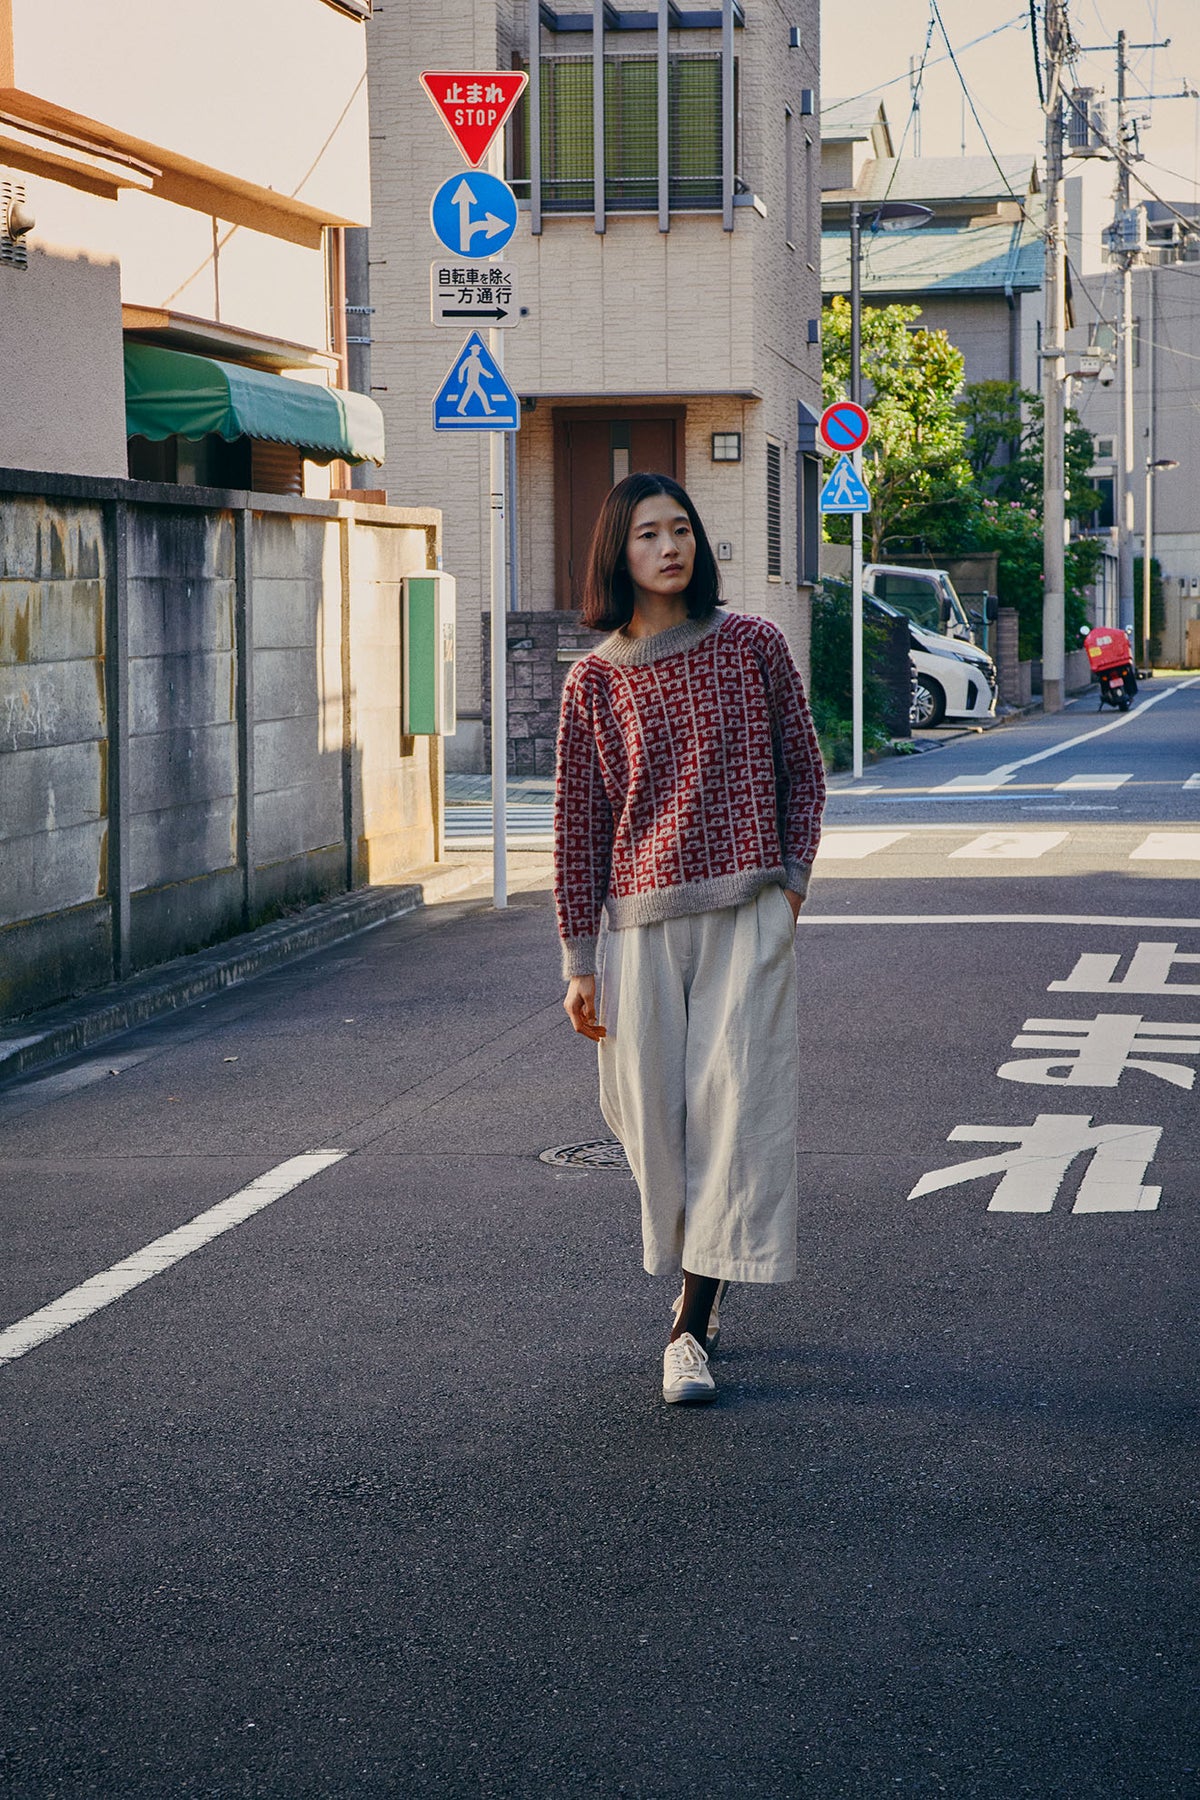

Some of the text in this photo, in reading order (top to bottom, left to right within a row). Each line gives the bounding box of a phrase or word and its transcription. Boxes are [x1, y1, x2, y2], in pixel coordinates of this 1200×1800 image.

[443, 82, 505, 104] 止まれ
[455, 109, 497, 126] STOP
[438, 268, 511, 285] 自転車を除く
[438, 287, 512, 304] 一方通行
